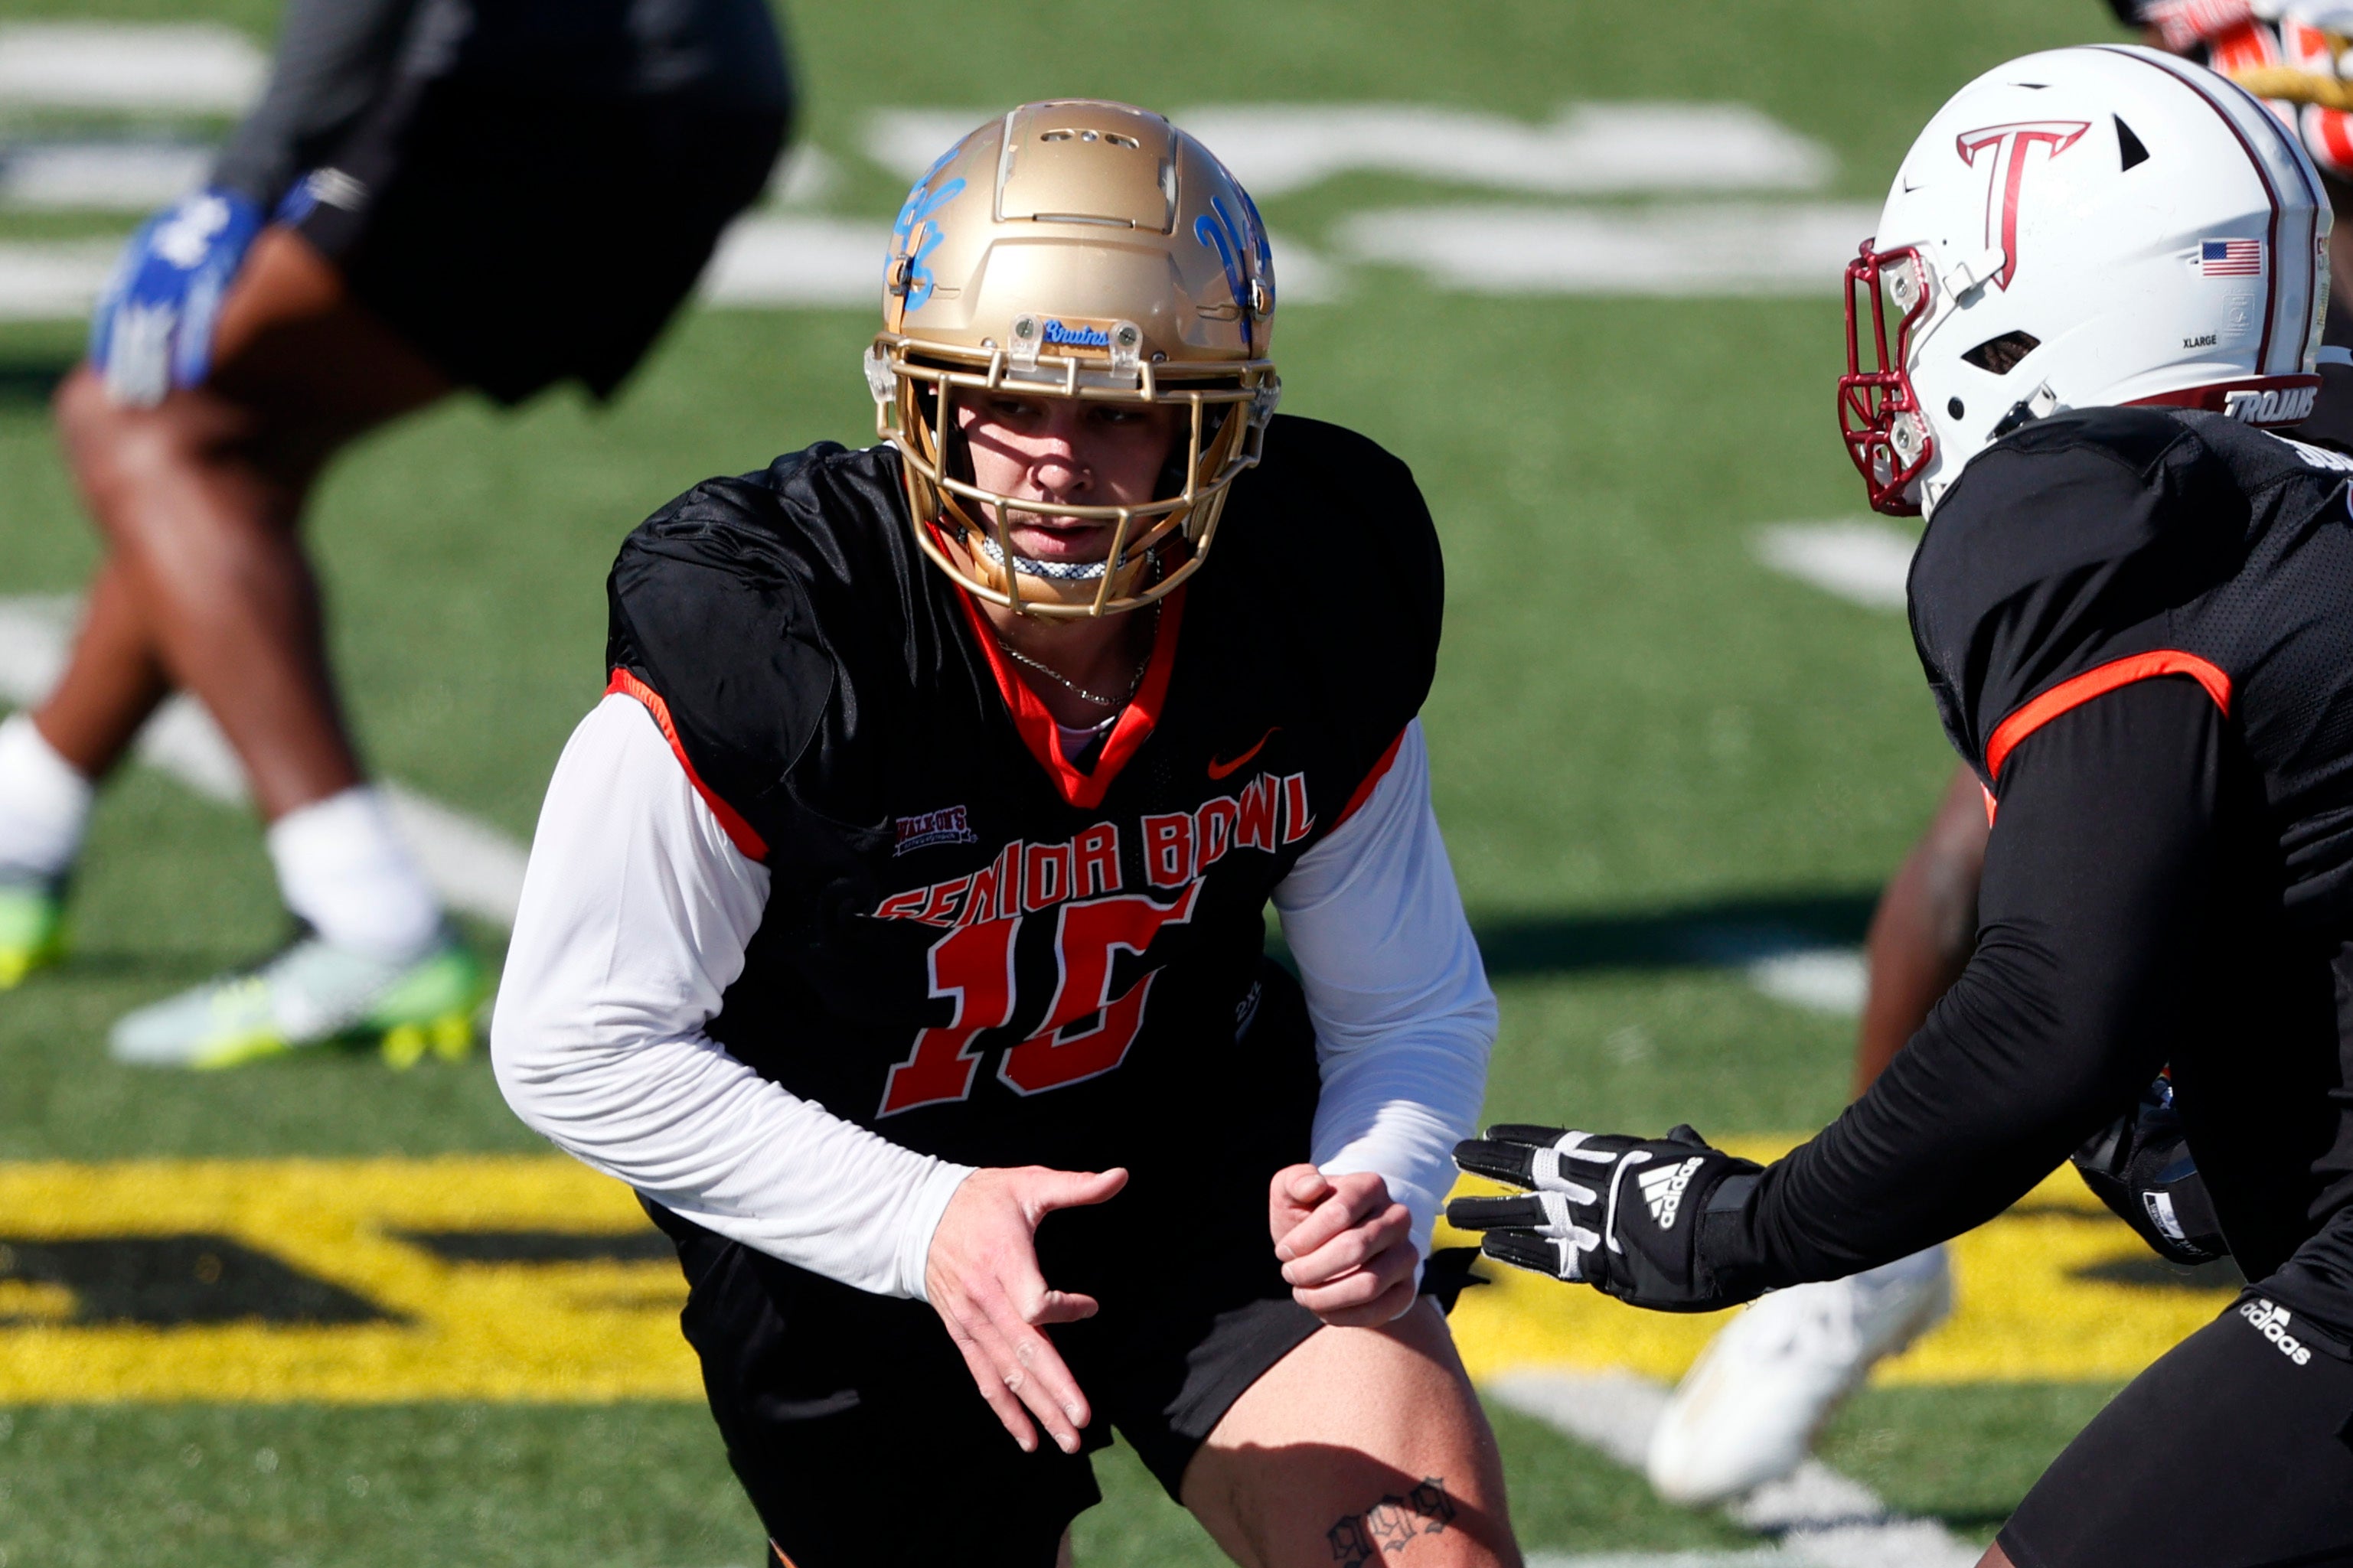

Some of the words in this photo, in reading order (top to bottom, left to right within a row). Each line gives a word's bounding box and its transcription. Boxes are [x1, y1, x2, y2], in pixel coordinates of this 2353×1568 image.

[1043, 319, 1109, 346] Bruins
[2183, 334, 2217, 349] XLARGE
[2224, 386, 2318, 423] TROJANS
[871, 821, 1122, 927] SENIOR
[1141, 771, 1317, 888] BOWL
[1659, 1156, 1704, 1229] adidas
[2240, 1302, 2311, 1365] adidas
